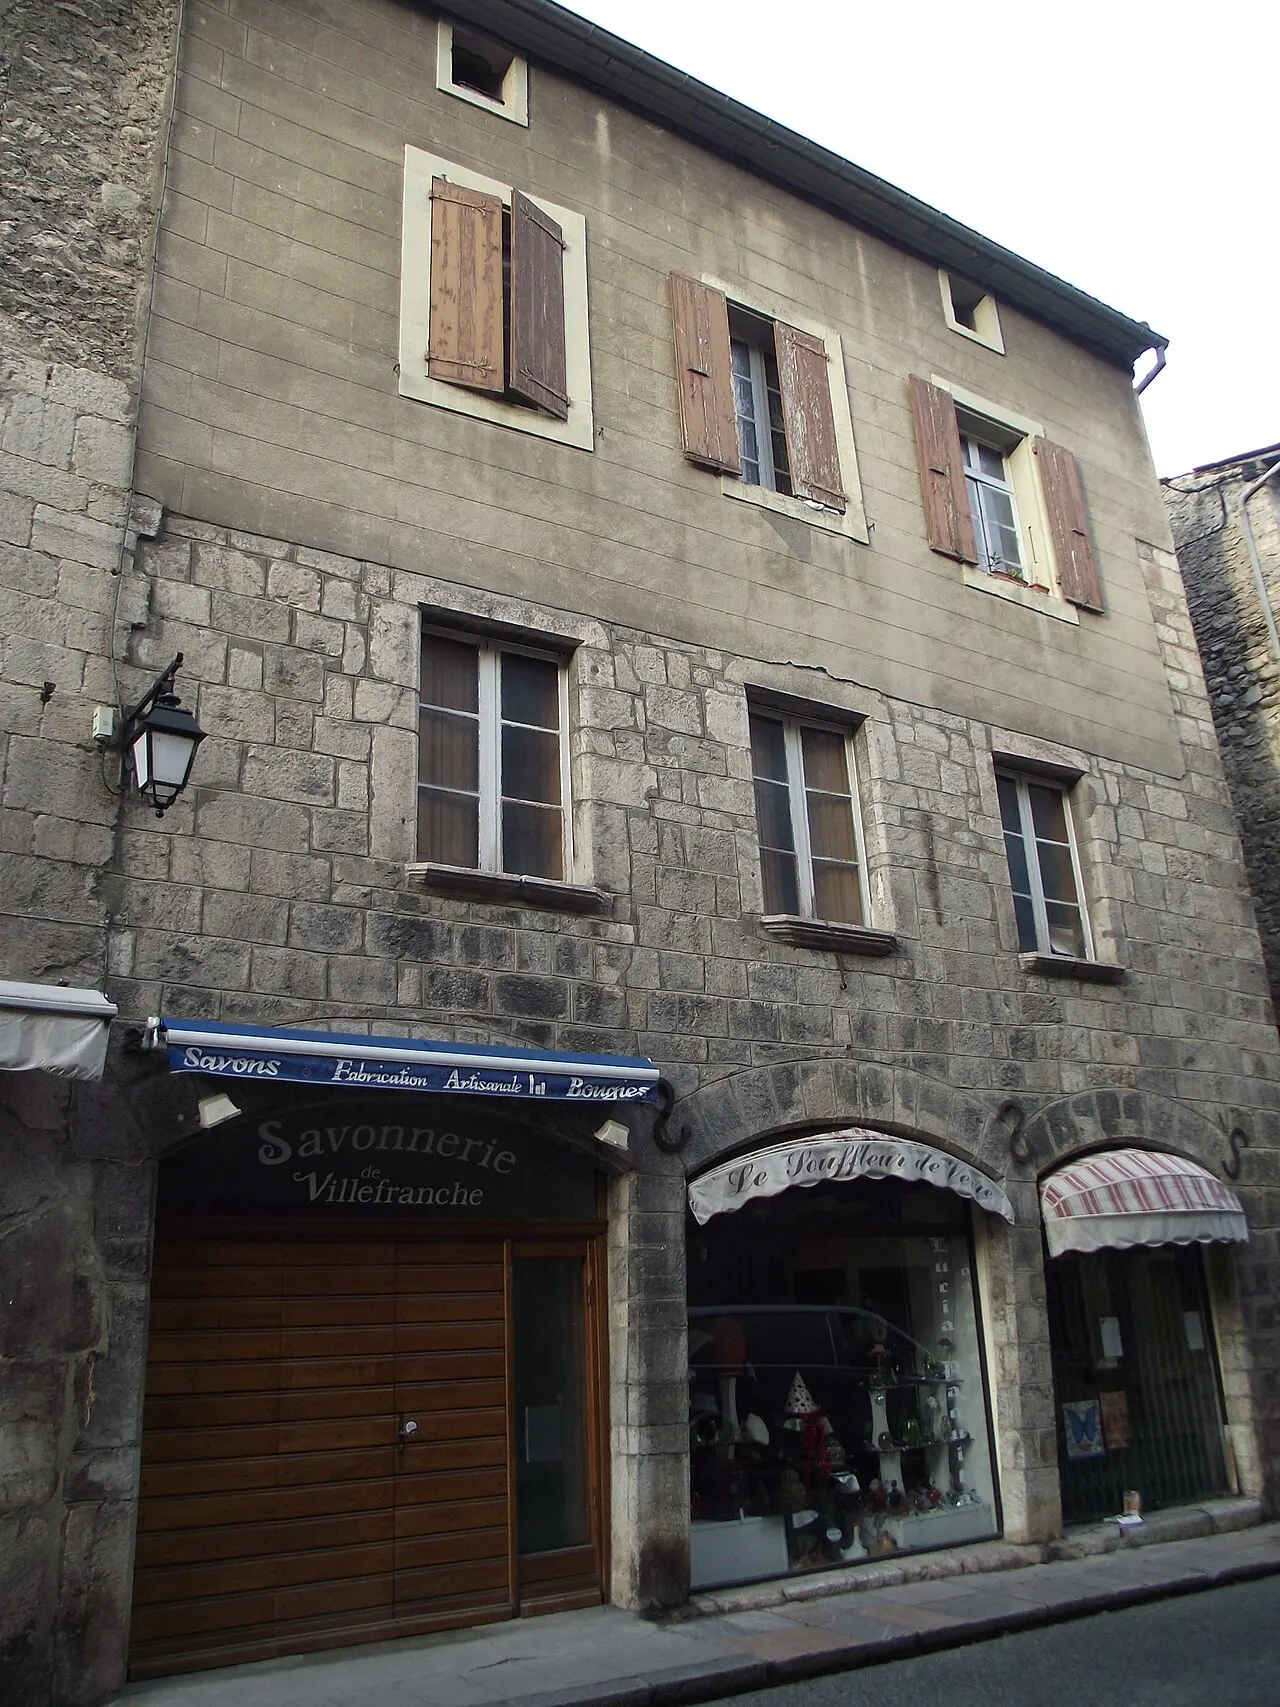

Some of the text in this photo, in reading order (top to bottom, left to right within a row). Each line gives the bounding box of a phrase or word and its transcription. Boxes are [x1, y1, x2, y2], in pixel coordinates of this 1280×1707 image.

[183, 1047, 282, 1076] Savons
[331, 1059, 522, 1093] Fabrication Artisanale
[566, 1077, 651, 1100] Bougies
[257, 1120, 517, 1174] Savonnerie
[360, 1165, 381, 1180] de
[728, 1163, 769, 1197] Le
[786, 1144, 907, 1178] Souffleur
[915, 1153, 941, 1173] de
[293, 1171, 484, 1206] Villefranche
